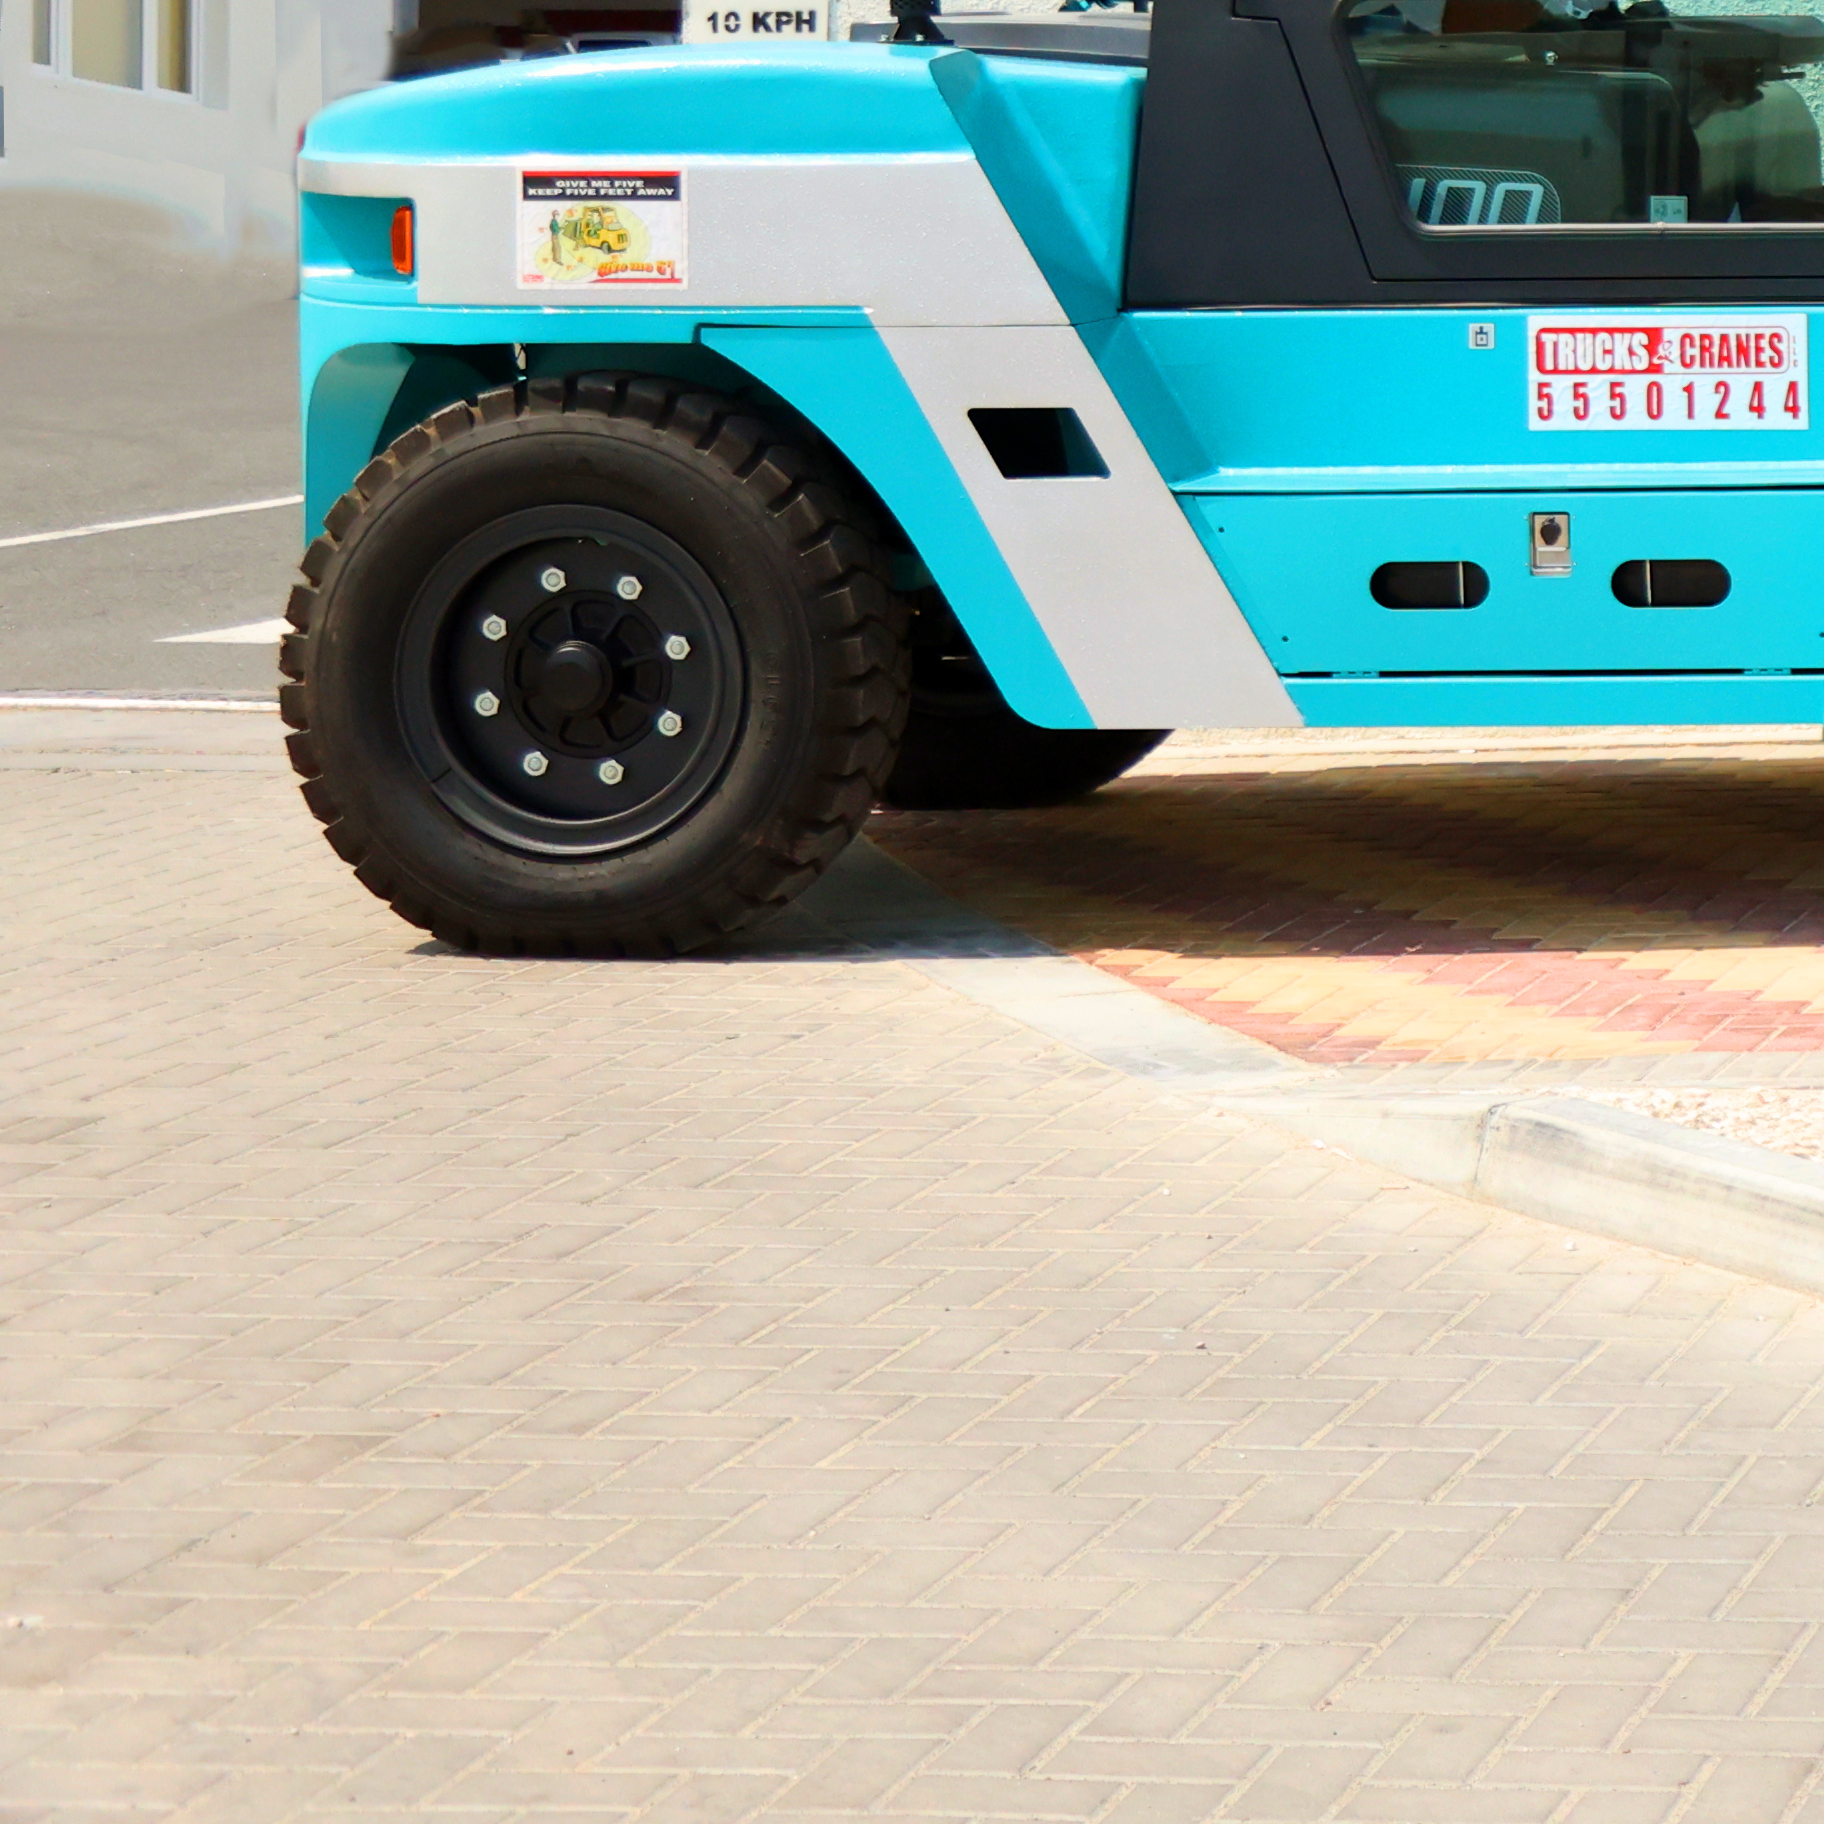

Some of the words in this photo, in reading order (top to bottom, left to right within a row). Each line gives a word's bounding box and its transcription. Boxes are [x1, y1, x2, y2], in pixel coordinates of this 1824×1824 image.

[706, 10, 742, 34] 10
[751, 9, 817, 34] KPH
[528, 188, 563, 196] KEEP
[566, 188, 597, 196] FIVE
[600, 188, 634, 196] FEET
[637, 188, 675, 196] AWAY
[555, 180, 588, 188] GIVE
[592, 180, 612, 188] ME
[614, 180, 645, 188] FIVE
[1540, 332, 1650, 371] TRUCKS
[1652, 339, 1675, 364] &
[1680, 332, 1785, 369] CRANES
